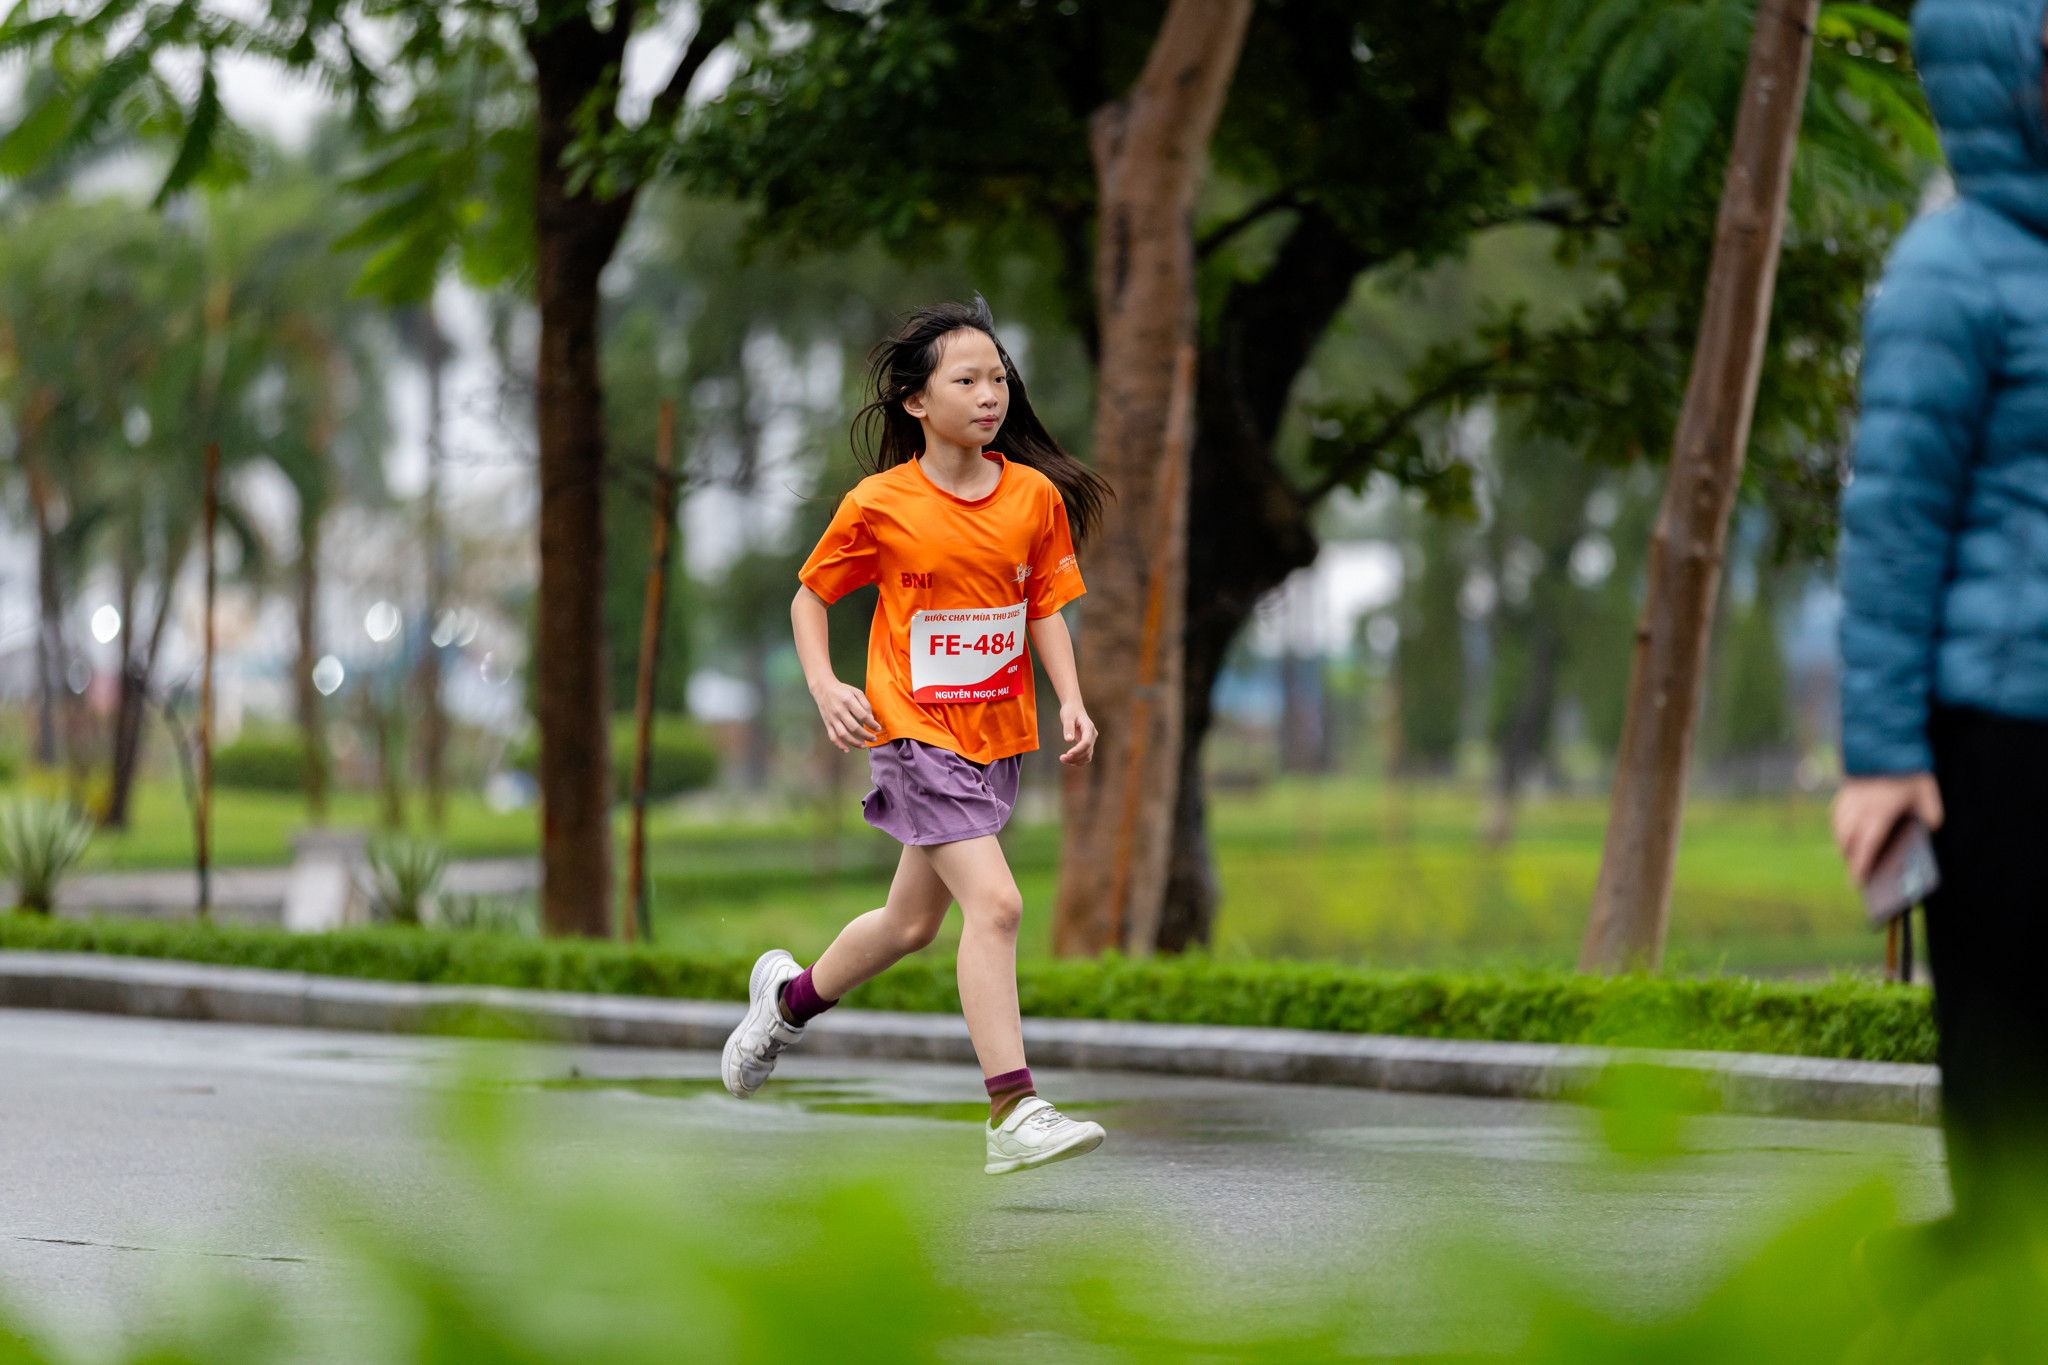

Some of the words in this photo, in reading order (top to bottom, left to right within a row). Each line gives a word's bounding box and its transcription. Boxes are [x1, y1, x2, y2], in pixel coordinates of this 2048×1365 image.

[924, 613, 946, 622] BƯỚC
[948, 613, 971, 623] CHẠY
[972, 612, 991, 622] MÙA
[992, 612, 1007, 621] THU
[1007, 609, 1020, 619] 2025
[930, 631, 1015, 655] FE-484
[935, 688, 971, 699] NGUYỄN
[973, 689, 997, 699] NGỌC
